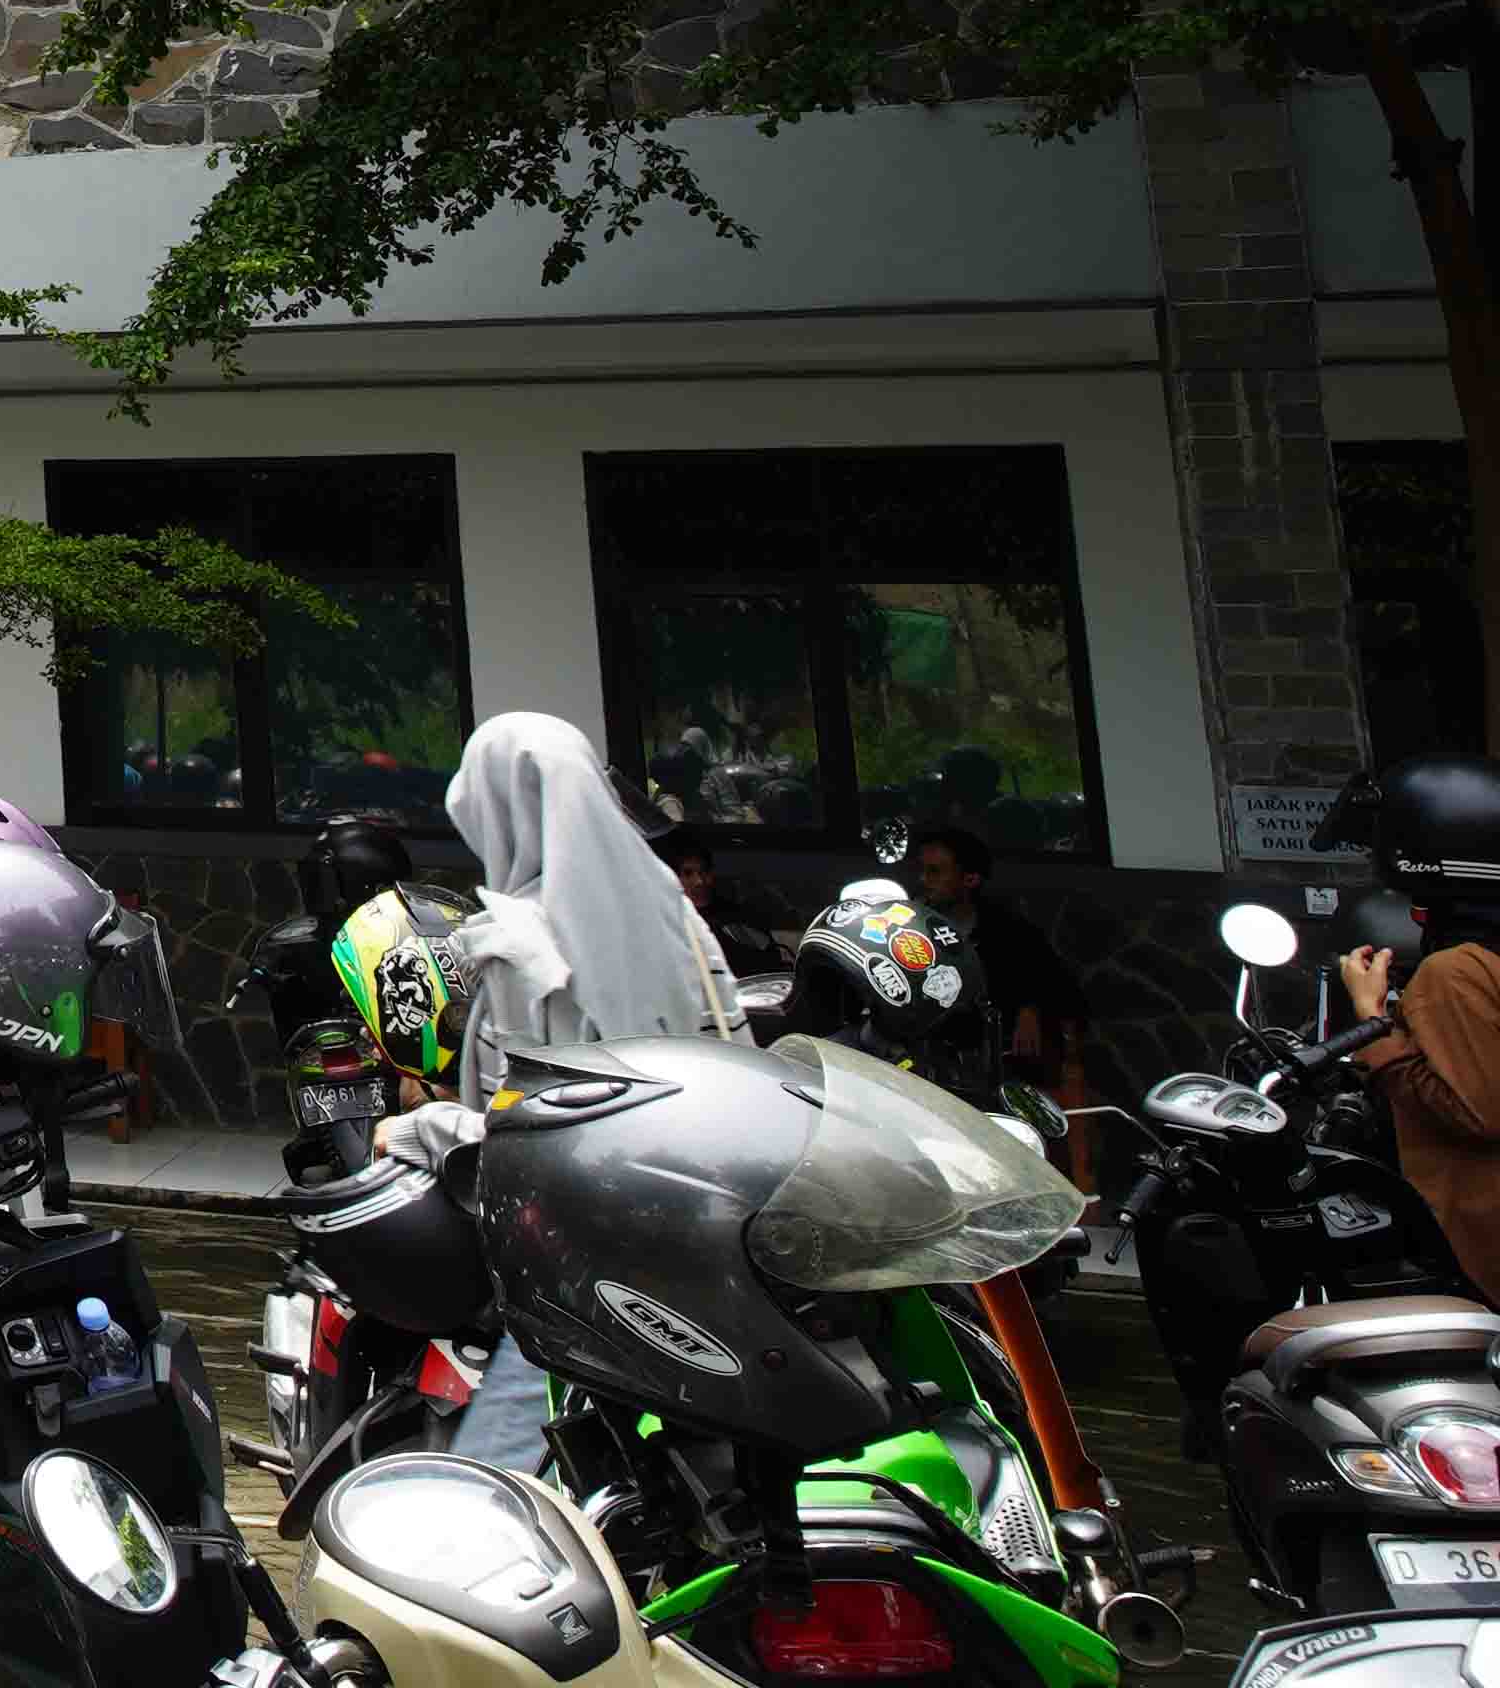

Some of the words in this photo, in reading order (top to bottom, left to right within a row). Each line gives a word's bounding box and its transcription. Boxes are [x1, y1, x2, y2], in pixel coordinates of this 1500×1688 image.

[1247, 799, 1300, 811] JARAK
[1257, 817, 1301, 831] SATU
[1262, 837, 1305, 850] DARI
[1396, 857, 1441, 874] Retro
[872, 959, 906, 1000] VANS
[621, 1300, 720, 1356] GMT
[1394, 1549, 1418, 1580] D
[1446, 1548, 1500, 1580] 36
[1284, 1624, 1370, 1664] VARIO
